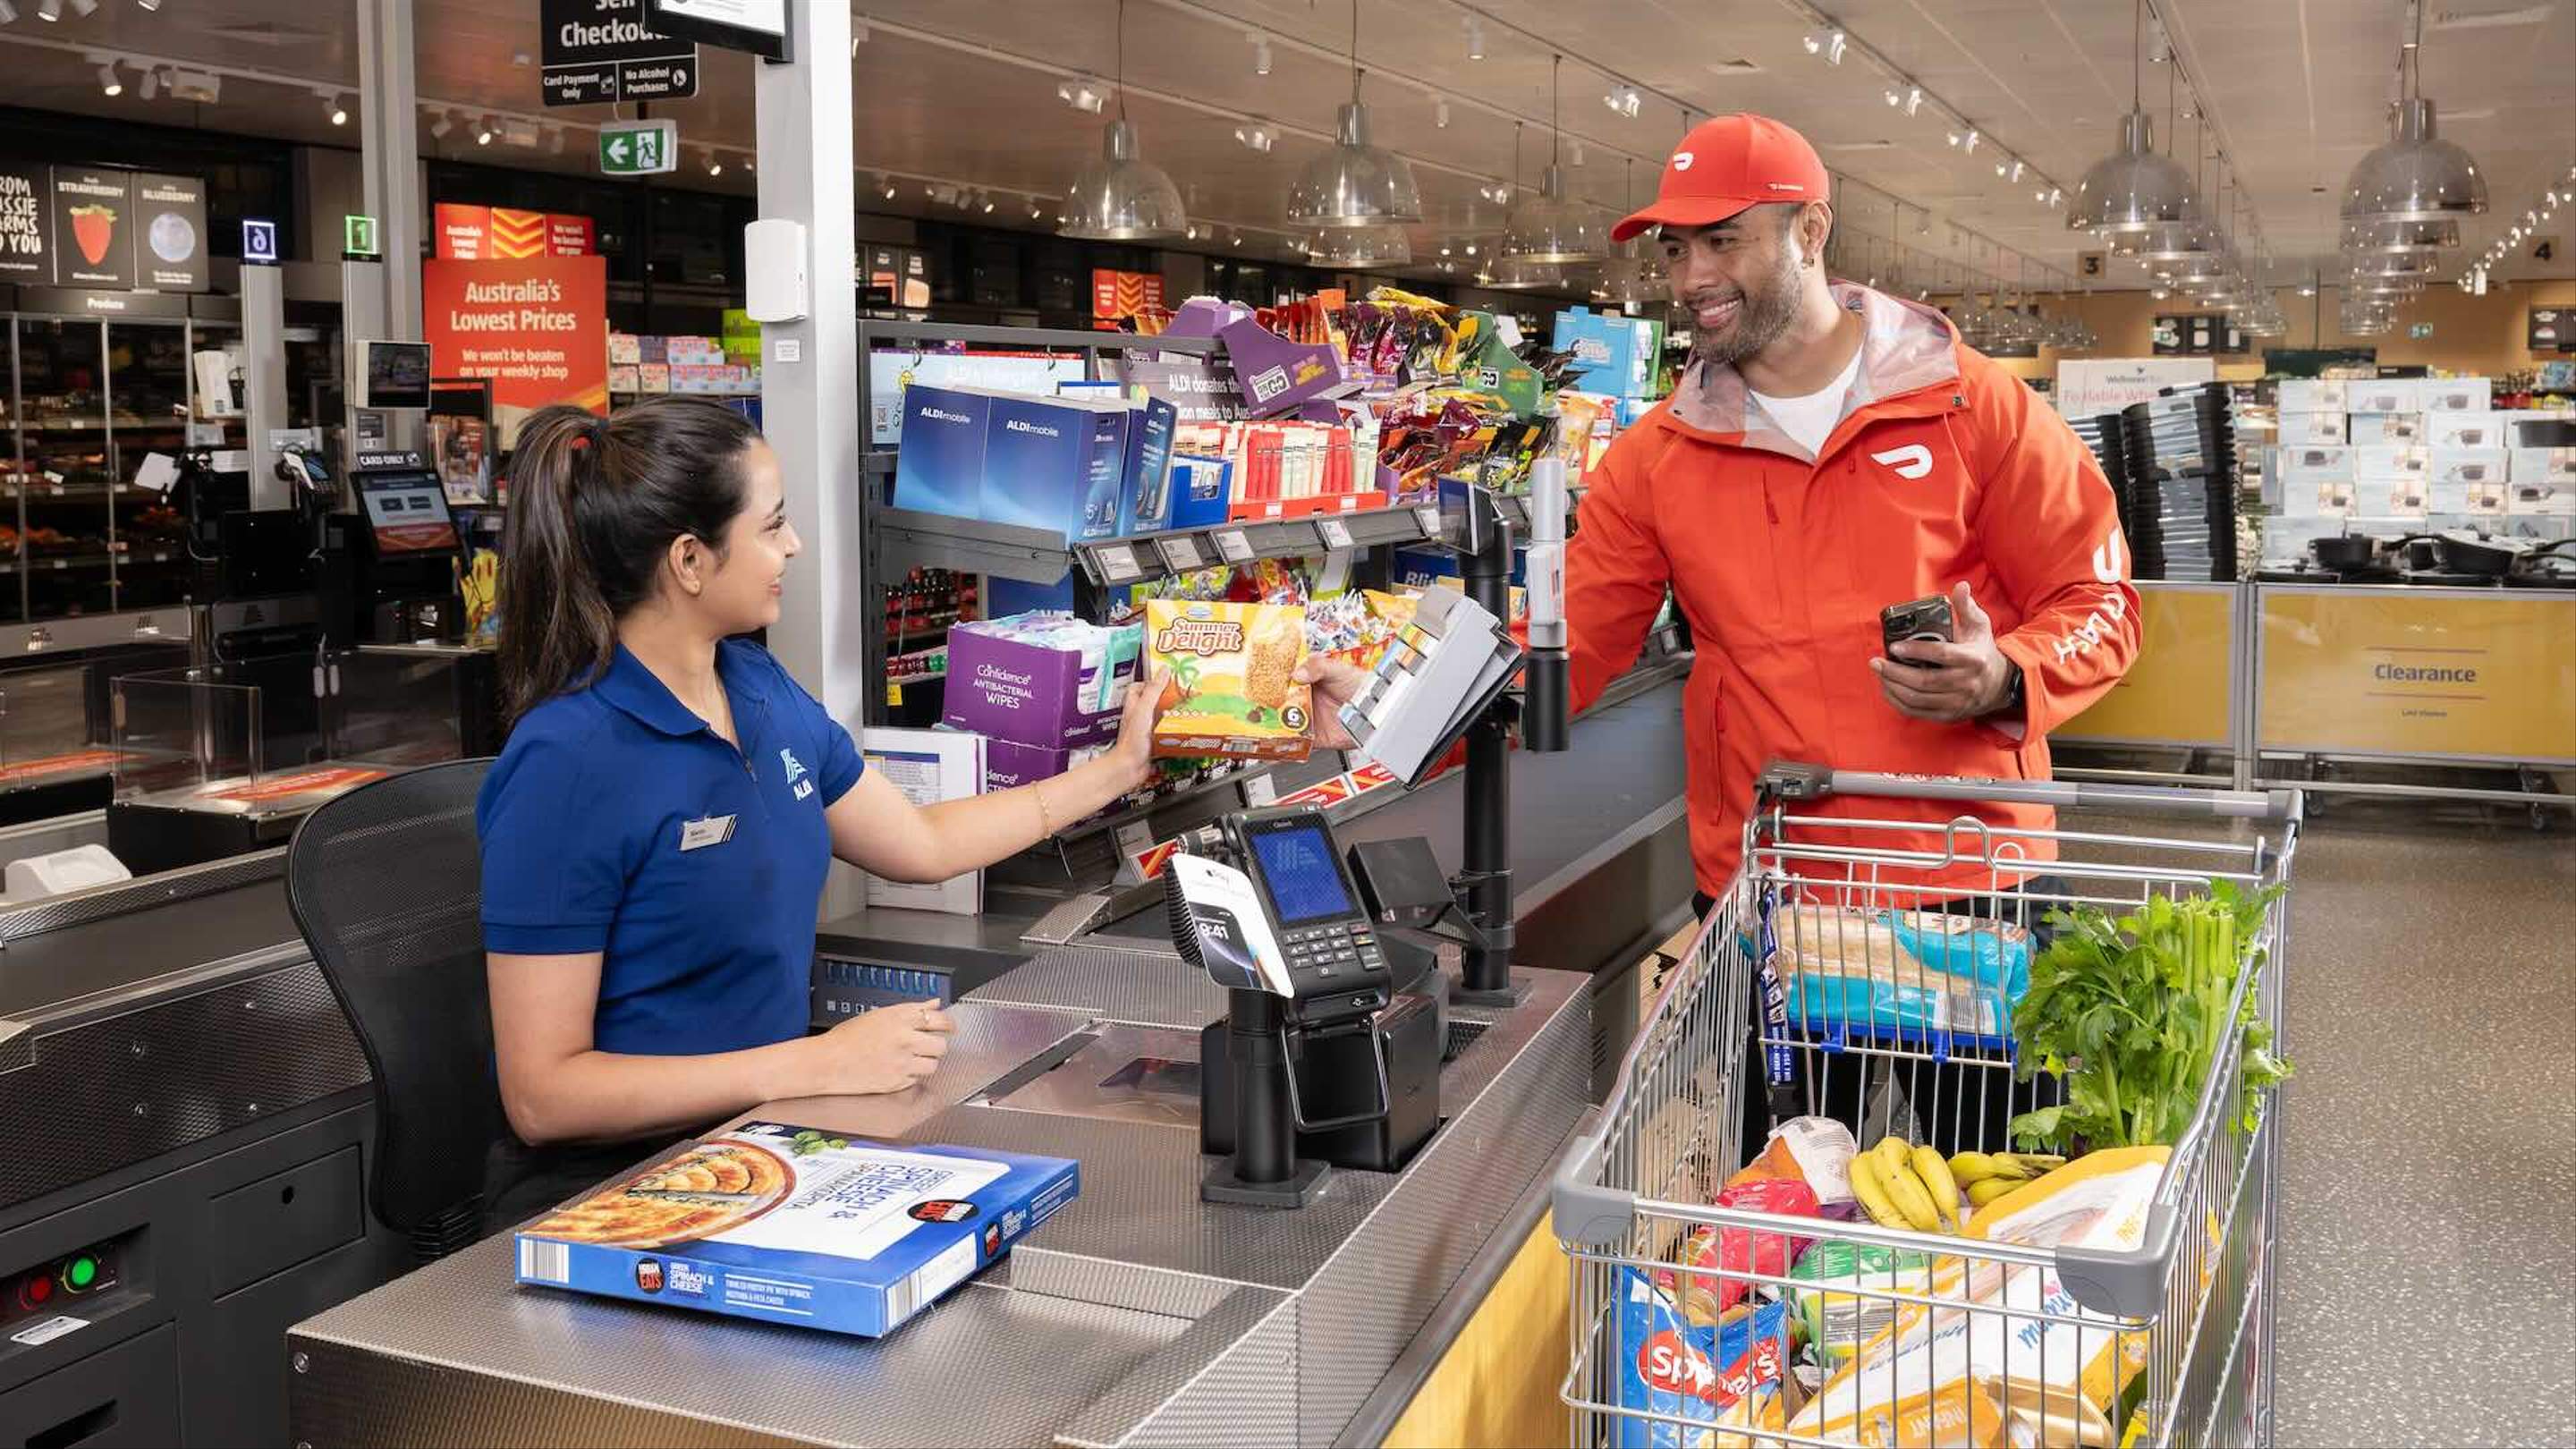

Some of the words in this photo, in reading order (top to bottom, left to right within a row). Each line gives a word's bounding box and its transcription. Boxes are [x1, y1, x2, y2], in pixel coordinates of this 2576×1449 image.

[561, 18, 672, 47] Checkou
[544, 75, 563, 86] Card
[564, 72, 599, 88] Payment
[626, 70, 637, 80] No
[638, 67, 670, 79] Alcohol
[562, 88, 581, 100] Only
[627, 82, 669, 94] Purchases
[0, 175, 30, 197] ROM
[0, 196, 38, 216] SSIE
[0, 215, 38, 234] RMS
[9, 233, 42, 254] YOU
[465, 279, 561, 303] Australia's
[451, 311, 515, 332] Lowest
[521, 307, 577, 331] Prices
[462, 350, 478, 362] We
[480, 350, 509, 362] won't
[511, 350, 525, 362] be
[527, 349, 564, 362] beaten
[460, 367, 474, 377] on
[476, 367, 500, 378] your
[502, 365, 538, 380] weekly
[541, 365, 569, 380] shop
[1169, 374, 1191, 392] ALDI
[1234, 402, 1250, 419] Aus
[1405, 571, 1435, 587] Bli
[1173, 619, 1241, 634] Summer
[1158, 630, 1243, 655] Delight
[2374, 664, 2477, 683] Clearance
[973, 679, 1034, 699] ANTIBACTERIAL
[986, 691, 1021, 709] WIPES
[1199, 922, 1230, 940] 9:41
